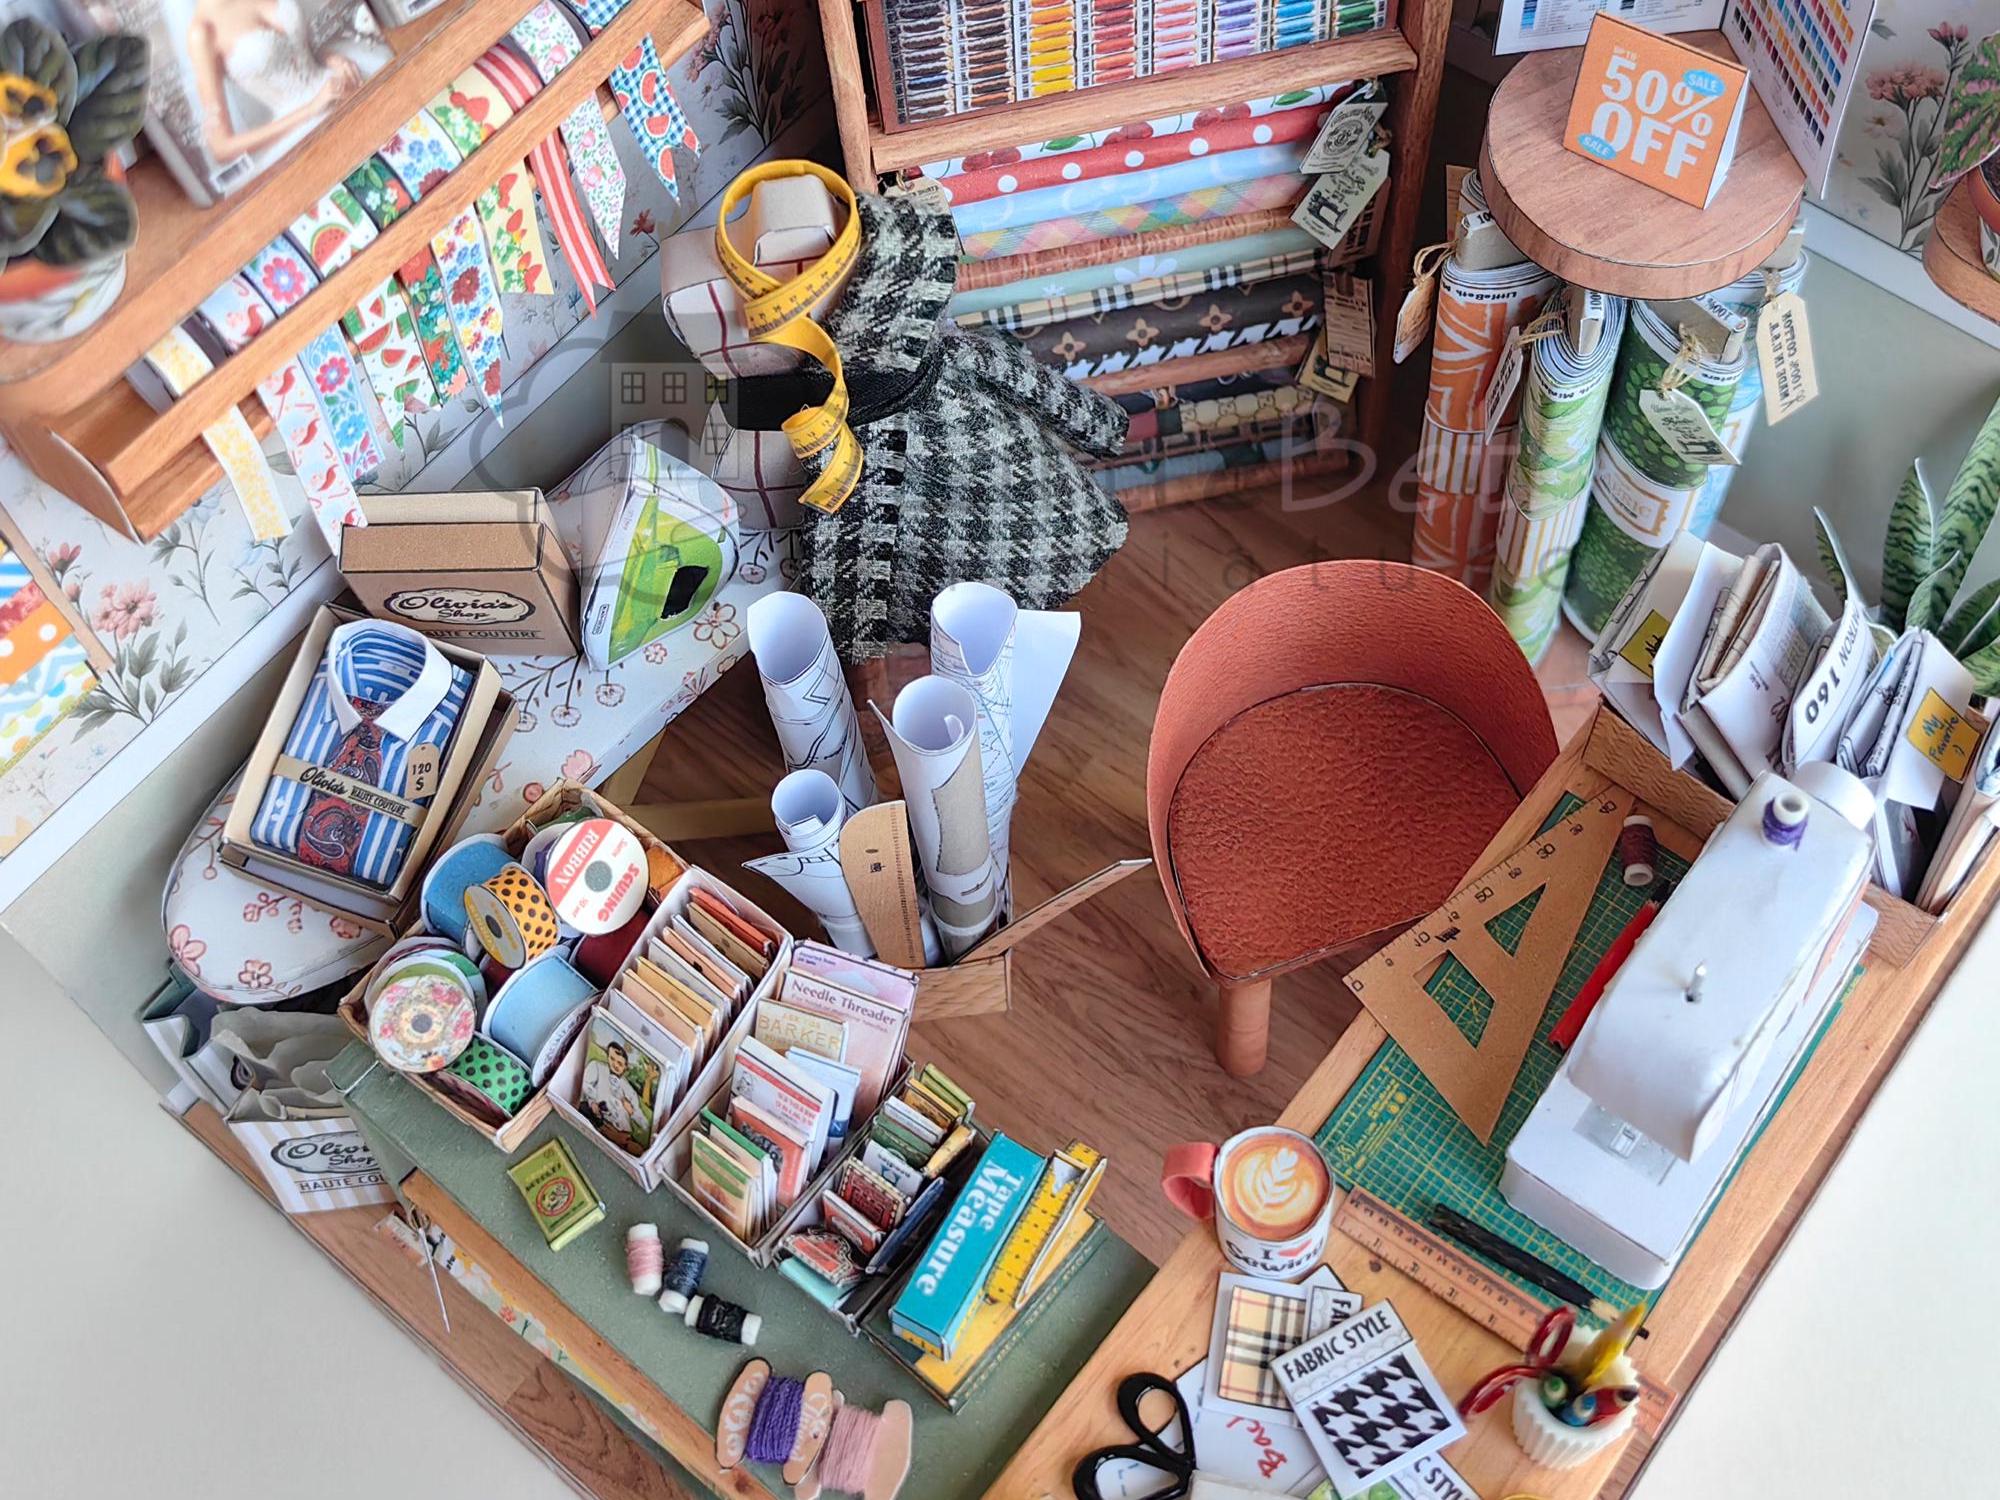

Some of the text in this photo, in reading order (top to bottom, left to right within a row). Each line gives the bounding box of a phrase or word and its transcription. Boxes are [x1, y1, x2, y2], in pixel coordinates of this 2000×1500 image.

[1601, 55, 1718, 137] 50%
[1688, 74, 1719, 93] SALE
[1583, 137, 1611, 156] SALE
[1591, 101, 1706, 179] OFF
[400, 595, 518, 611] Olivia's
[438, 609, 490, 621] Shop
[420, 630, 538, 640] AUTE COUTURE
[1804, 666, 1842, 726] 160
[1921, 712, 1944, 737] My
[412, 761, 432, 776] 120
[373, 793, 409, 816] COUTURE
[555, 829, 600, 888] RIBBON
[597, 863, 640, 921] SEWING
[792, 979, 896, 1027] Needle Threader
[758, 1015, 841, 1051] BARKER
[300, 1180, 354, 1191] HAUTE
[978, 1174, 1024, 1233] Tape
[916, 1159, 1009, 1297] Measure
[1262, 1249, 1272, 1260] I
[1283, 1310, 1392, 1384] FABRIC STYLE
